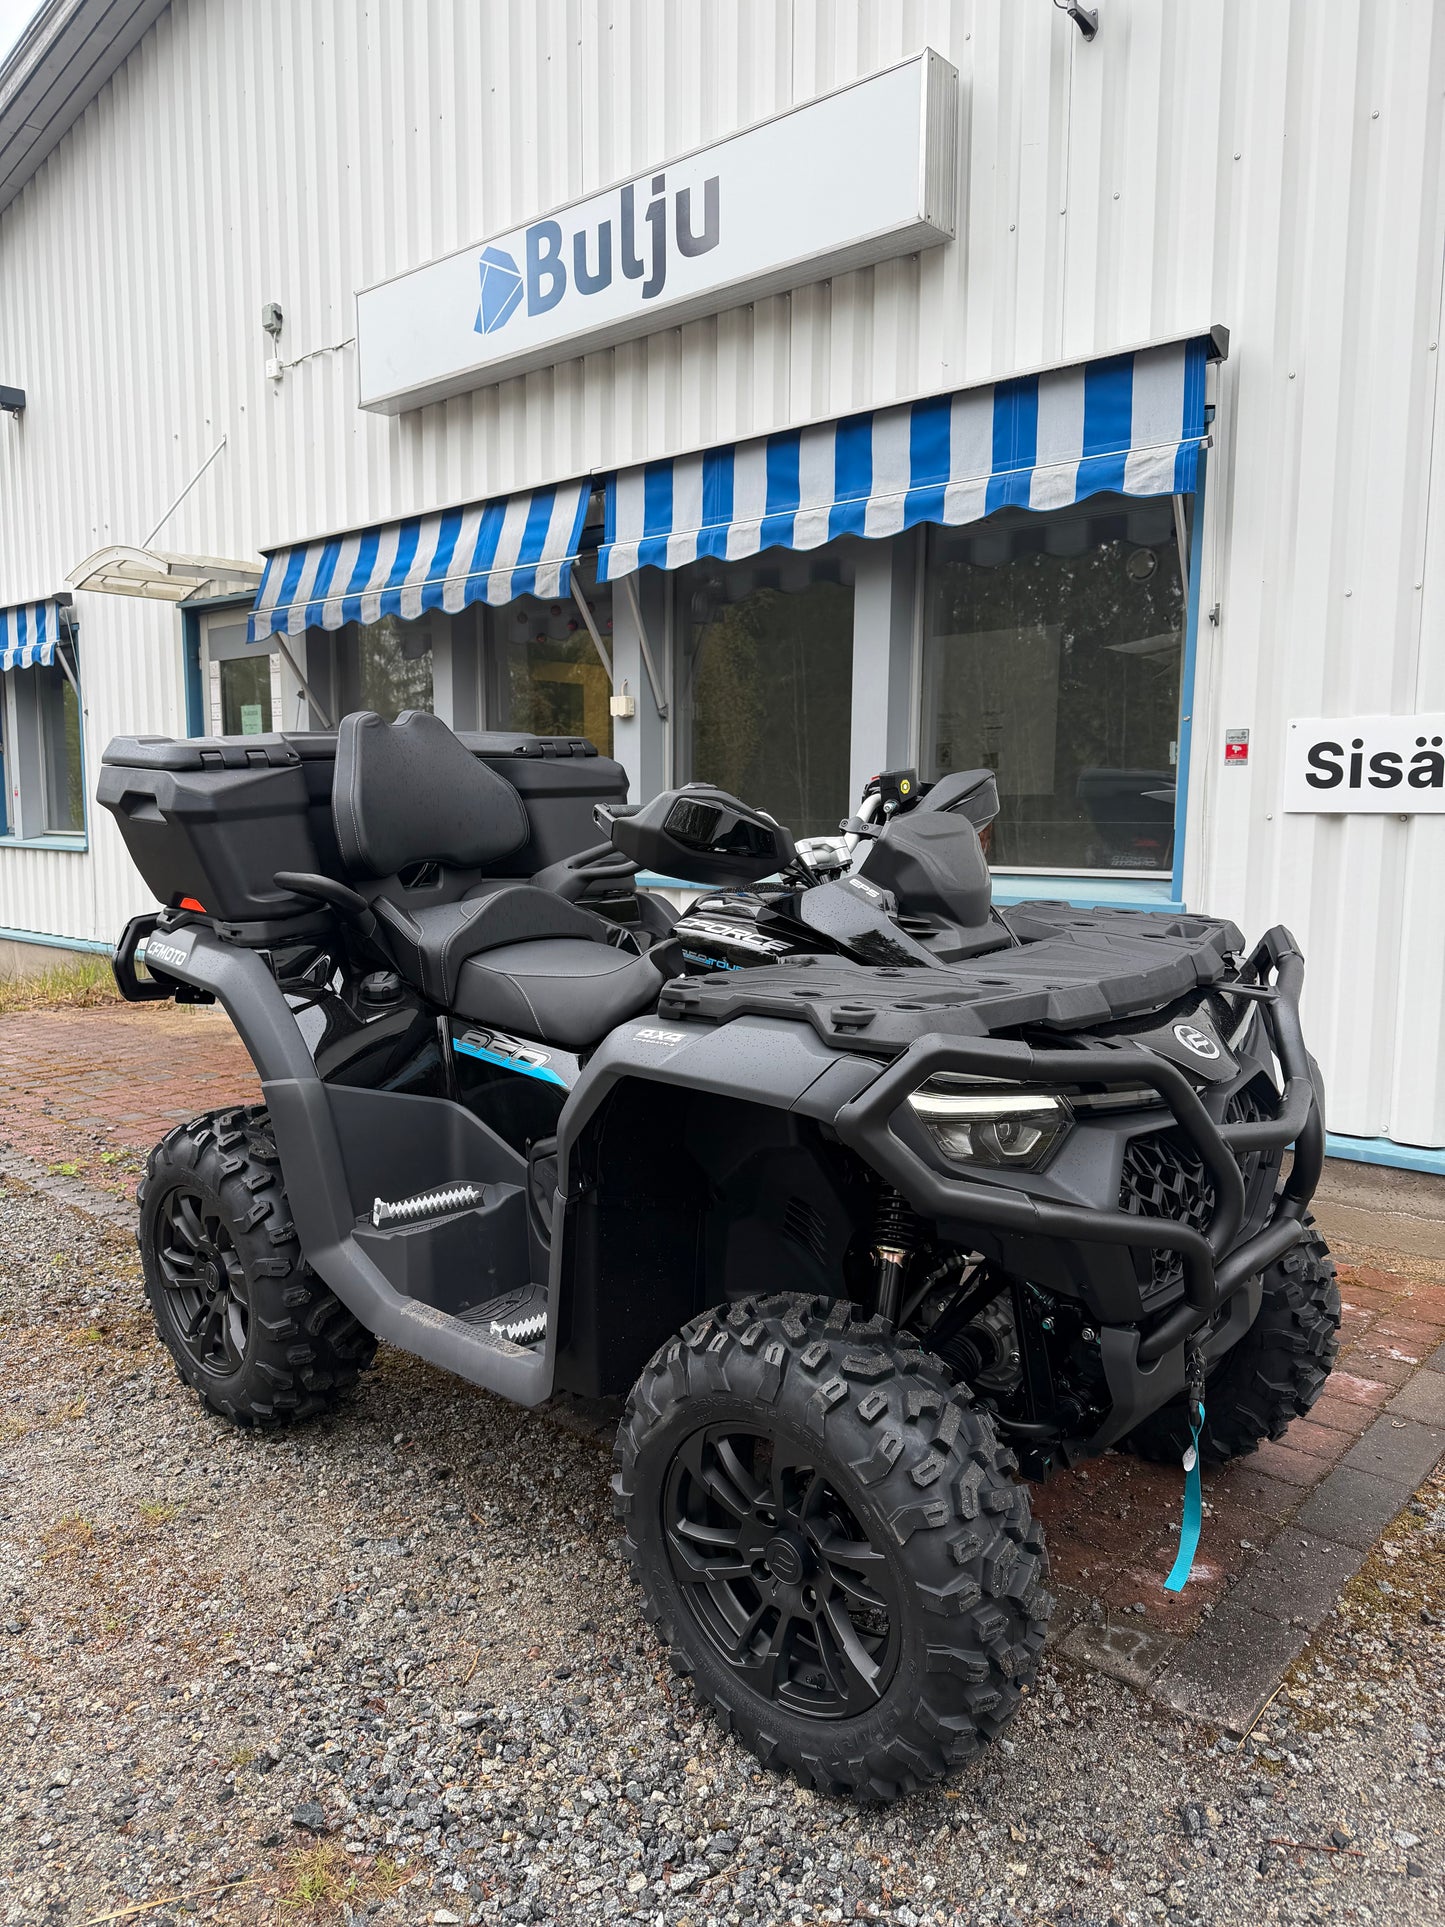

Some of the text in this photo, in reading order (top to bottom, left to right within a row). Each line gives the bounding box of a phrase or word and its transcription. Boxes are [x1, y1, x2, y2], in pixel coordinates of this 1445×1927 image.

[526, 173, 719, 317] Bulju
[1305, 736, 1445, 789] Sisä
[849, 878, 880, 898] EPS
[147, 941, 188, 966] CFMOTO
